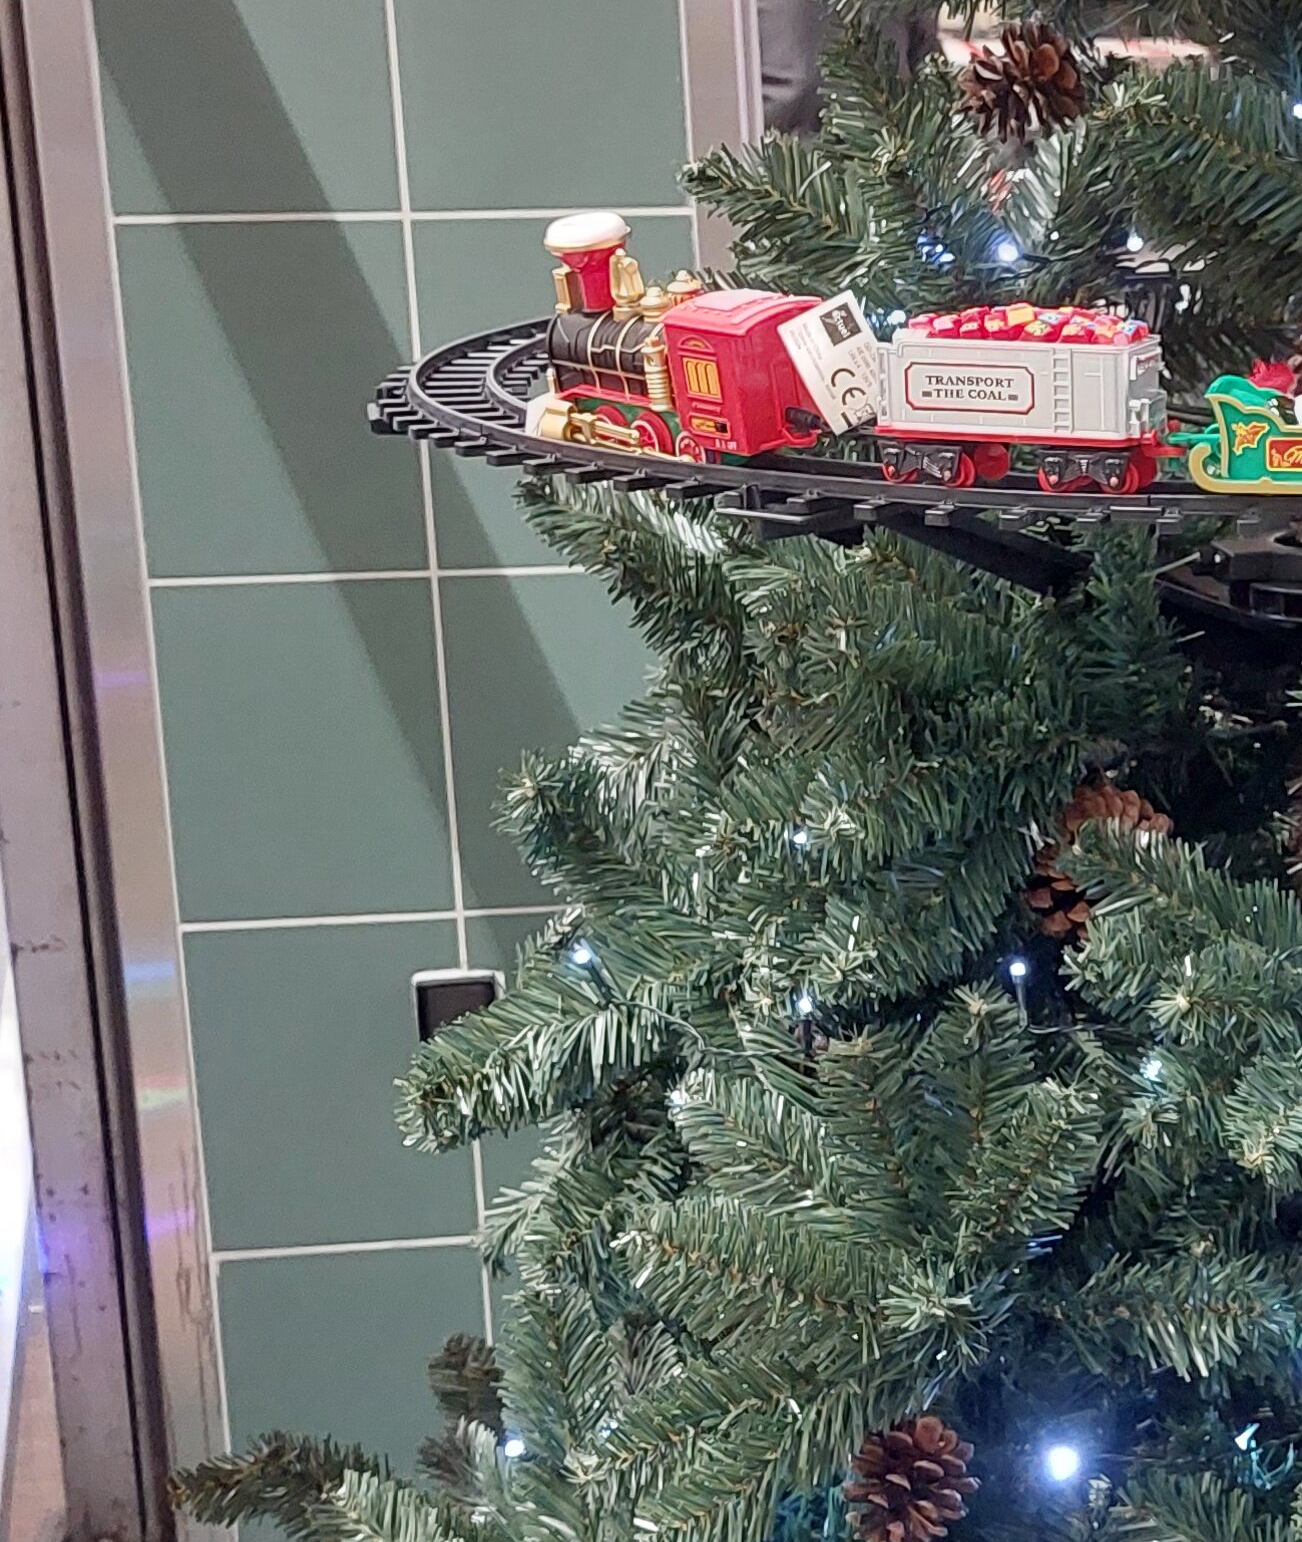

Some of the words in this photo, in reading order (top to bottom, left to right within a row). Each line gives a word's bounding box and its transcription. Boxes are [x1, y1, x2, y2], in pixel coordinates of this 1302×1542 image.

[925, 375, 1014, 388] TRANSPORT
[933, 388, 964, 399] THE
[968, 389, 1007, 401] COAL
